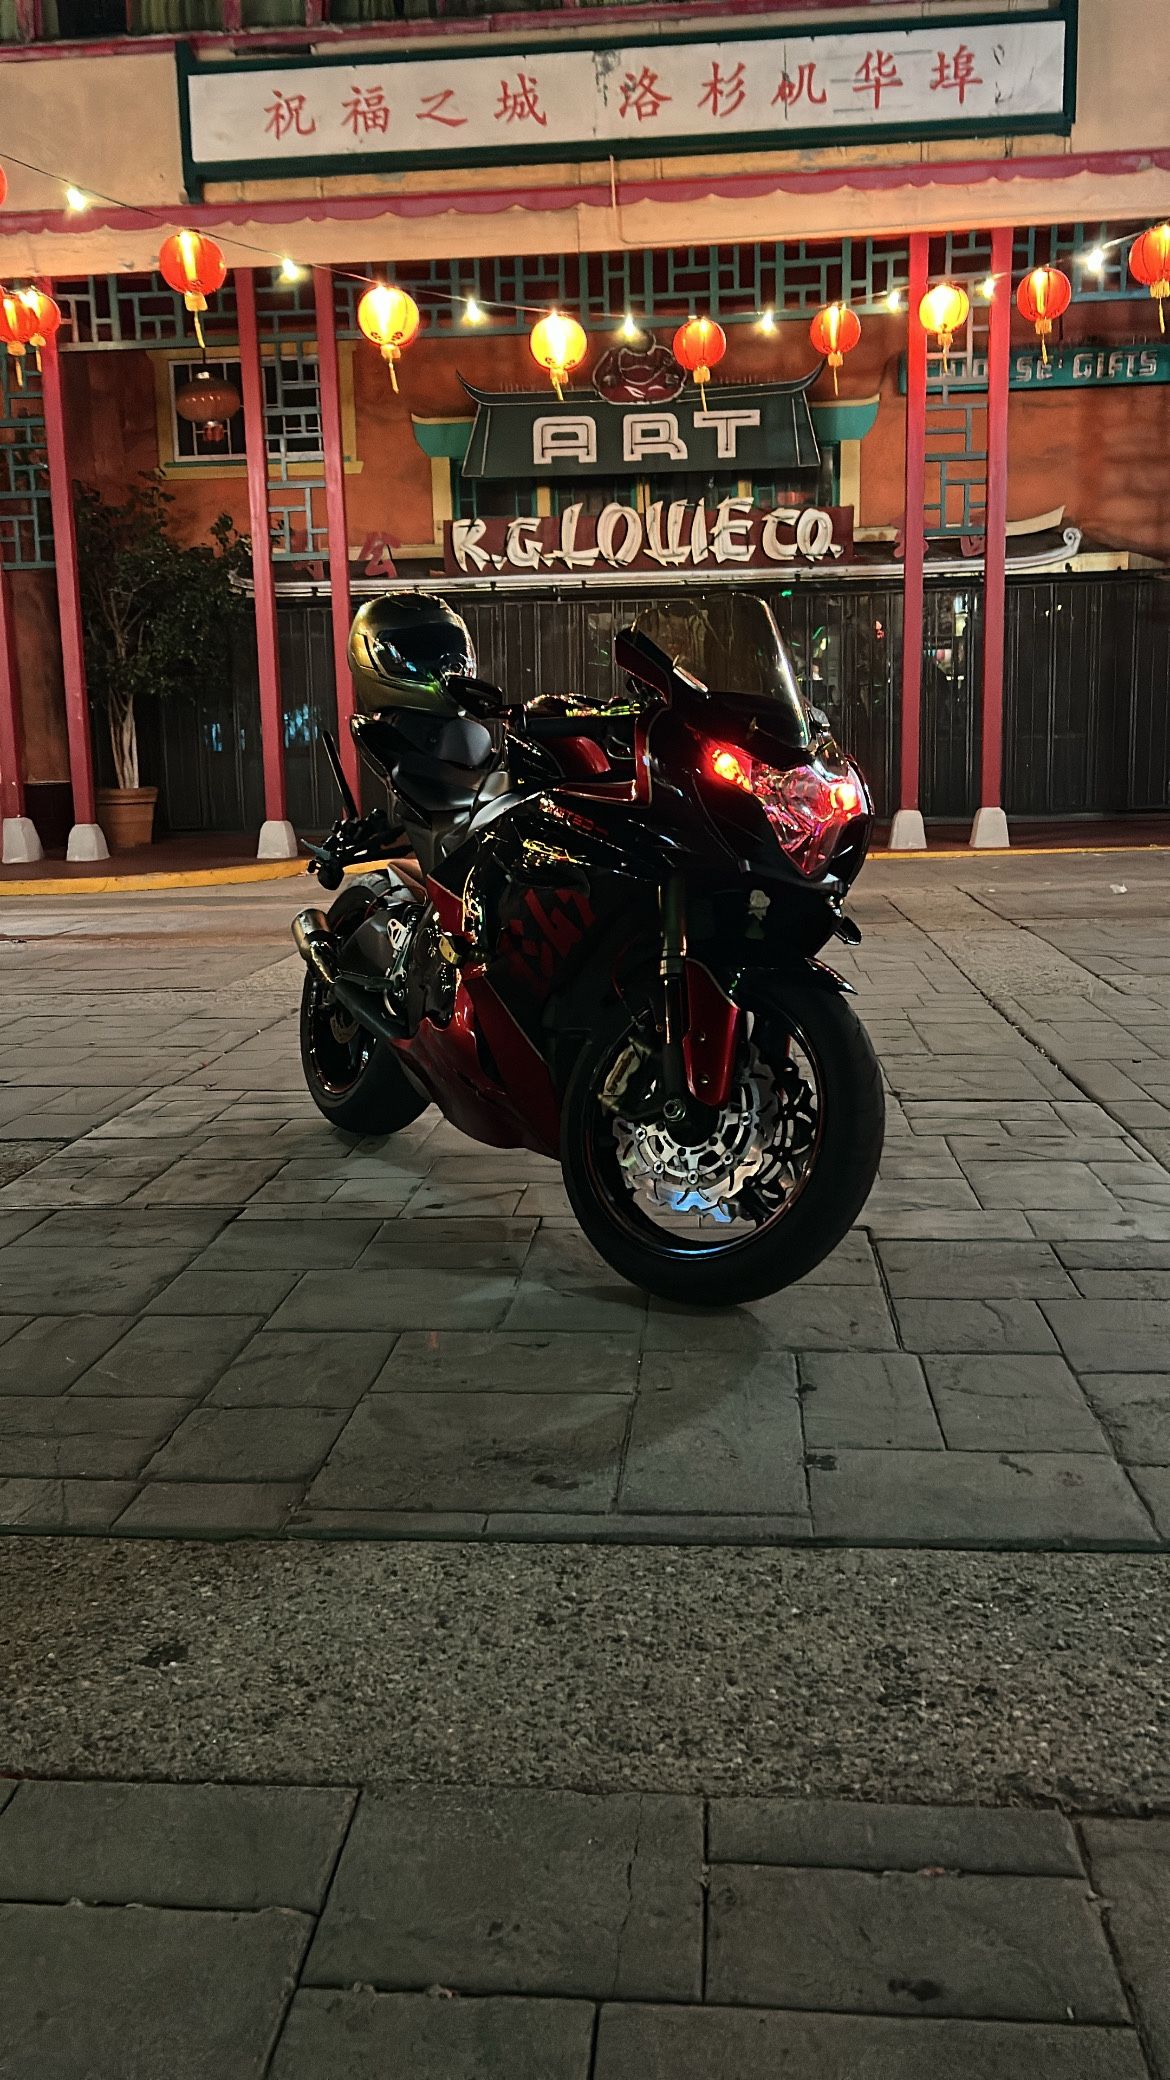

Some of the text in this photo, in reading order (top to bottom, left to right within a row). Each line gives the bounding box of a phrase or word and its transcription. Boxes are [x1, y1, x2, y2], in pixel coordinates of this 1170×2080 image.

[263, 44, 983, 141] 祝福之城 洛杉矶华埠
[1072, 350, 1158, 379] GIFTS
[533, 409, 761, 465] ART
[553, 496, 757, 569] LOUIE
